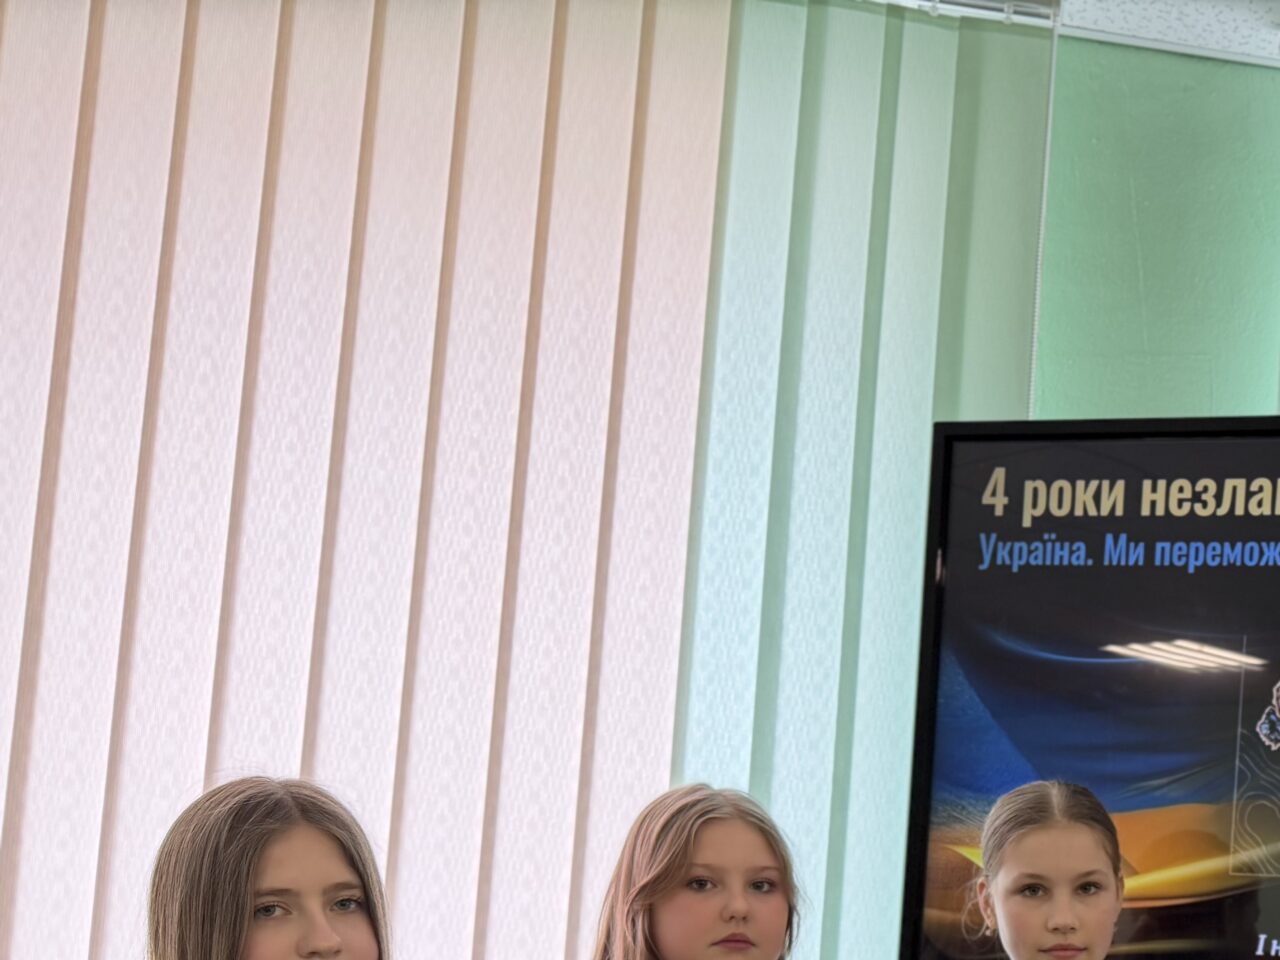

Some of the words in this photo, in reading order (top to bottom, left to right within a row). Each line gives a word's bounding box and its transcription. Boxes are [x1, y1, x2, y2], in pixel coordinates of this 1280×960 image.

[982, 467, 1009, 517] 4
[1022, 478, 1125, 528] роки
[979, 533, 1093, 573] Україна.
[1103, 533, 1145, 566] Ми
[1255, 933, 1268, 956] І
